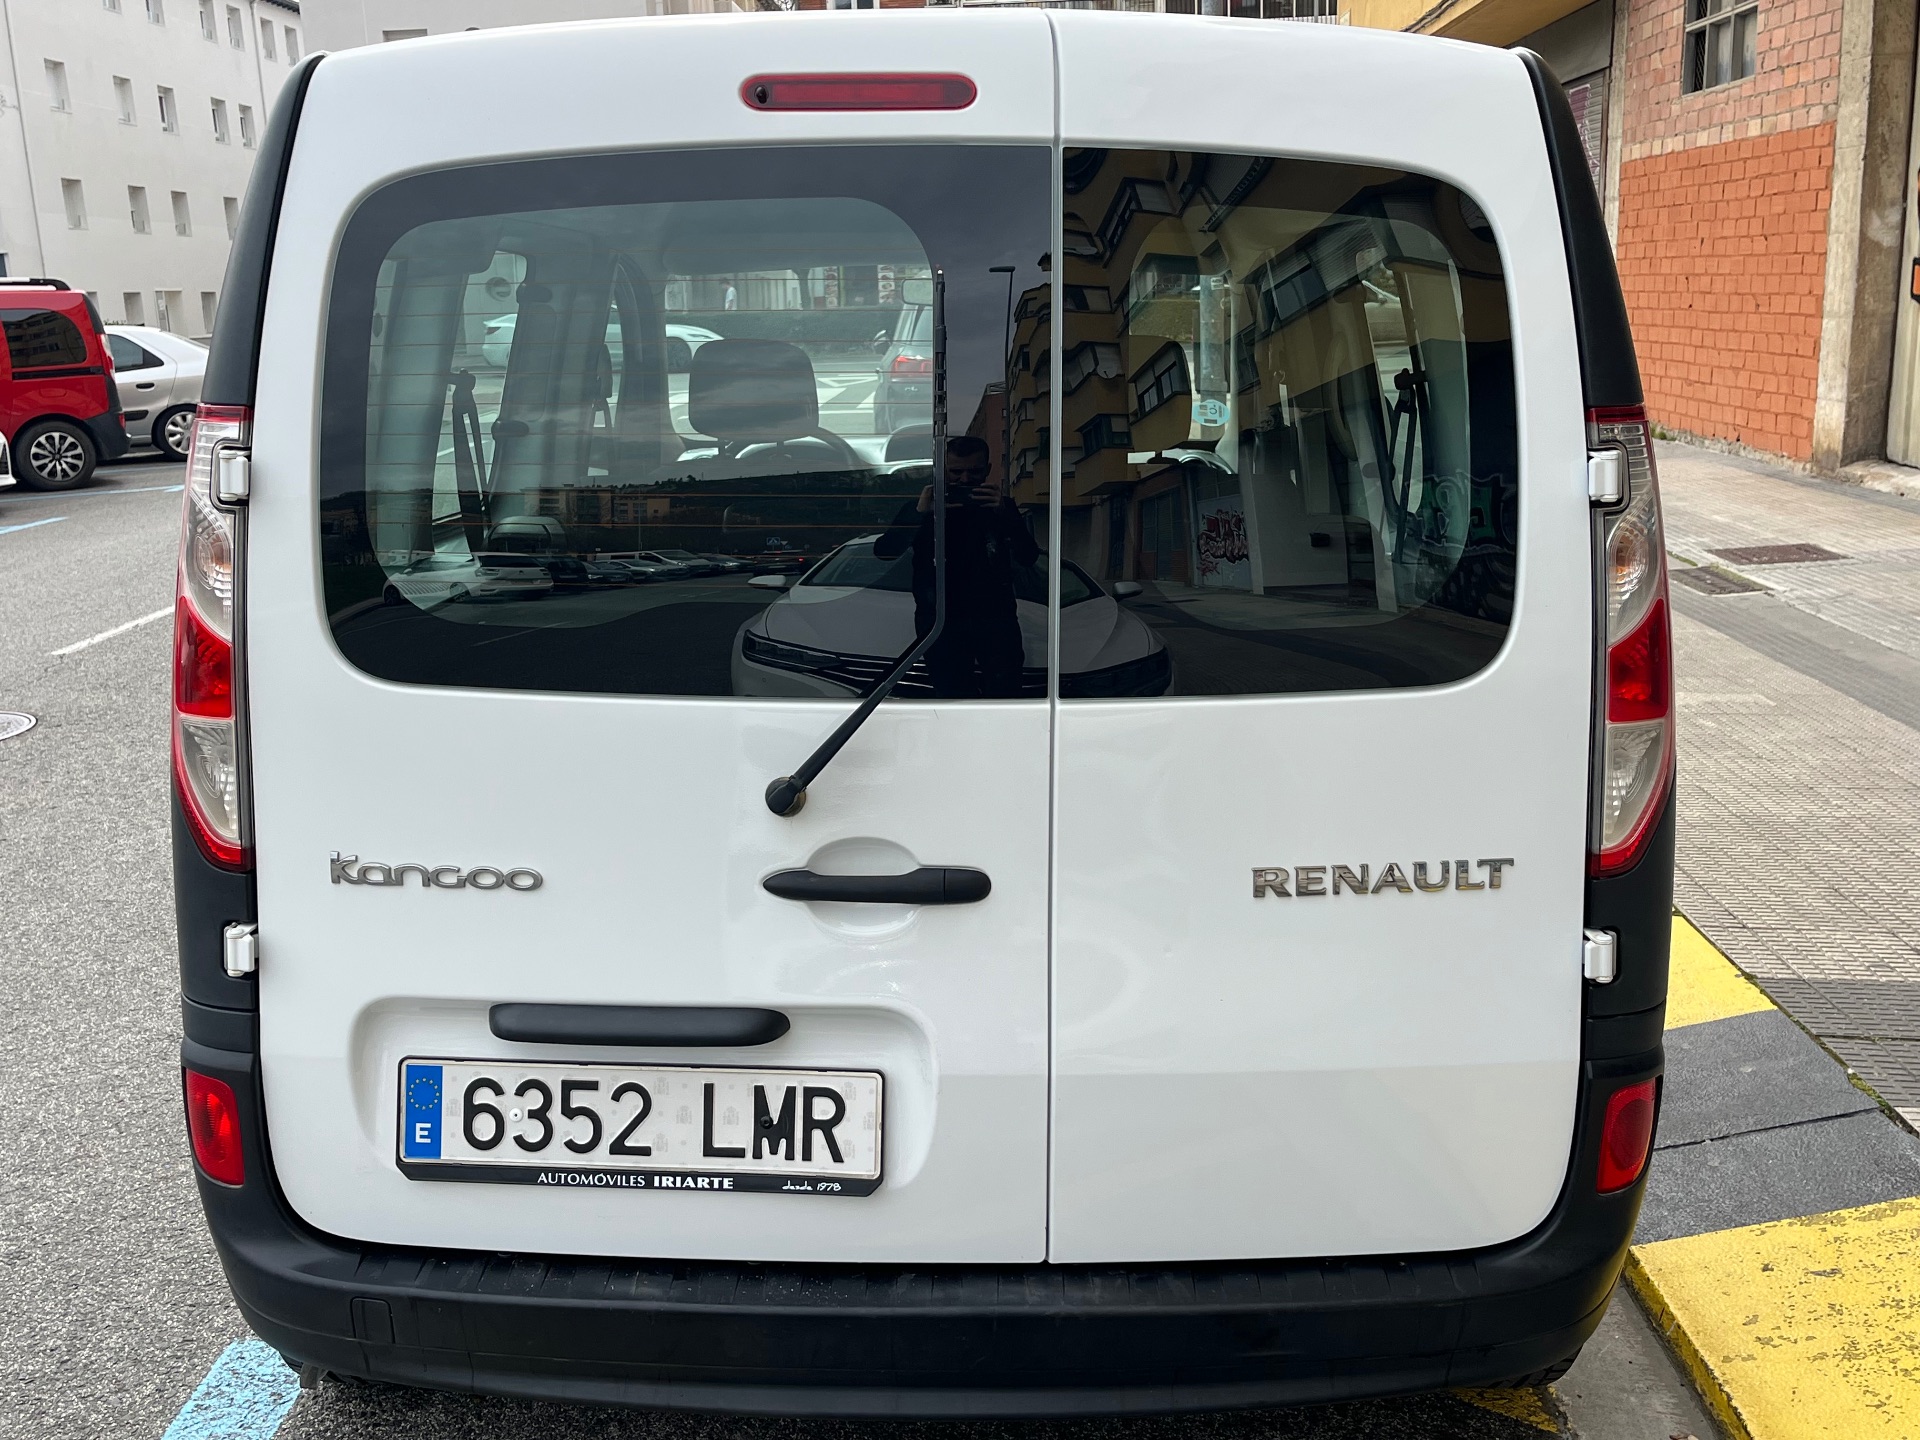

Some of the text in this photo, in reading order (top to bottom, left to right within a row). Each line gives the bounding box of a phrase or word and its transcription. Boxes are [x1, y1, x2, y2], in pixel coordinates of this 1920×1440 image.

[1251, 858, 1514, 898] RENAULT
[415, 1122, 432, 1144] E
[462, 1076, 846, 1163] 6352 LMR
[537, 1172, 645, 1188] AUTOMÓVILES
[653, 1175, 734, 1190] IRIARTE
[816, 1182, 842, 1192] 1978
